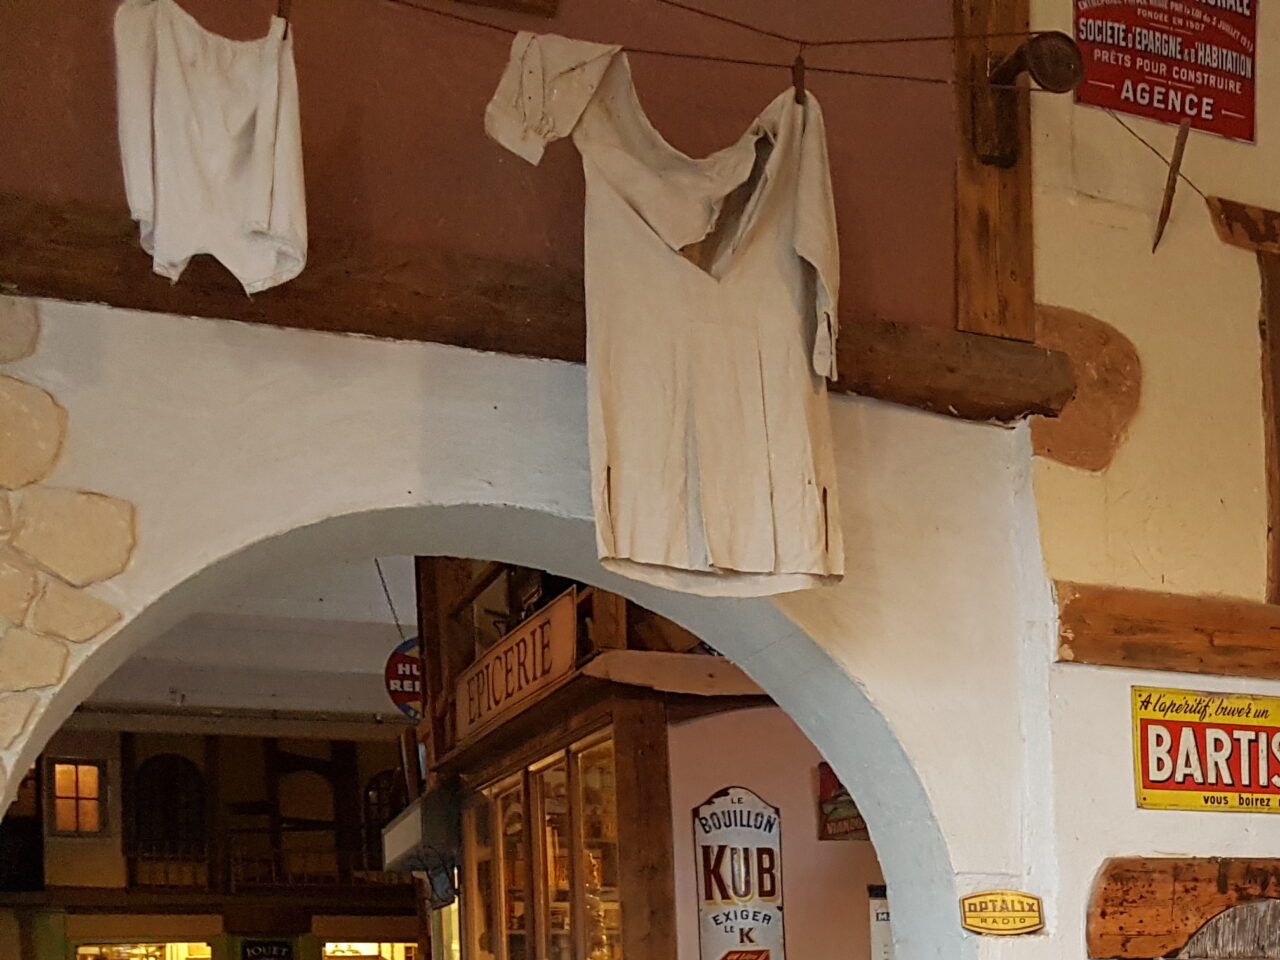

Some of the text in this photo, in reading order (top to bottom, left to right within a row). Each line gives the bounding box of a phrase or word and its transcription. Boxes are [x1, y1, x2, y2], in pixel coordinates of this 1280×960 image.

[1094, 49, 1242, 94] PRÊTS POUR CONSTRUIRE
[1121, 80, 1214, 120] AGENCE
[466, 618, 554, 726] EPICERIE
[1139, 693, 1153, 711] A
[1215, 698, 1252, 718] buvez
[1253, 708, 1270, 719] un
[730, 797, 744, 805] LE
[1203, 794, 1229, 805] vous
[1238, 794, 1271, 807] boirez
[700, 809, 777, 834] BOUILLON
[700, 844, 777, 901] KUB
[968, 899, 1036, 912] OPTALIX
[712, 909, 772, 926] EXIGER
[980, 917, 1026, 925] RADIO
[724, 925, 755, 944] LE K
